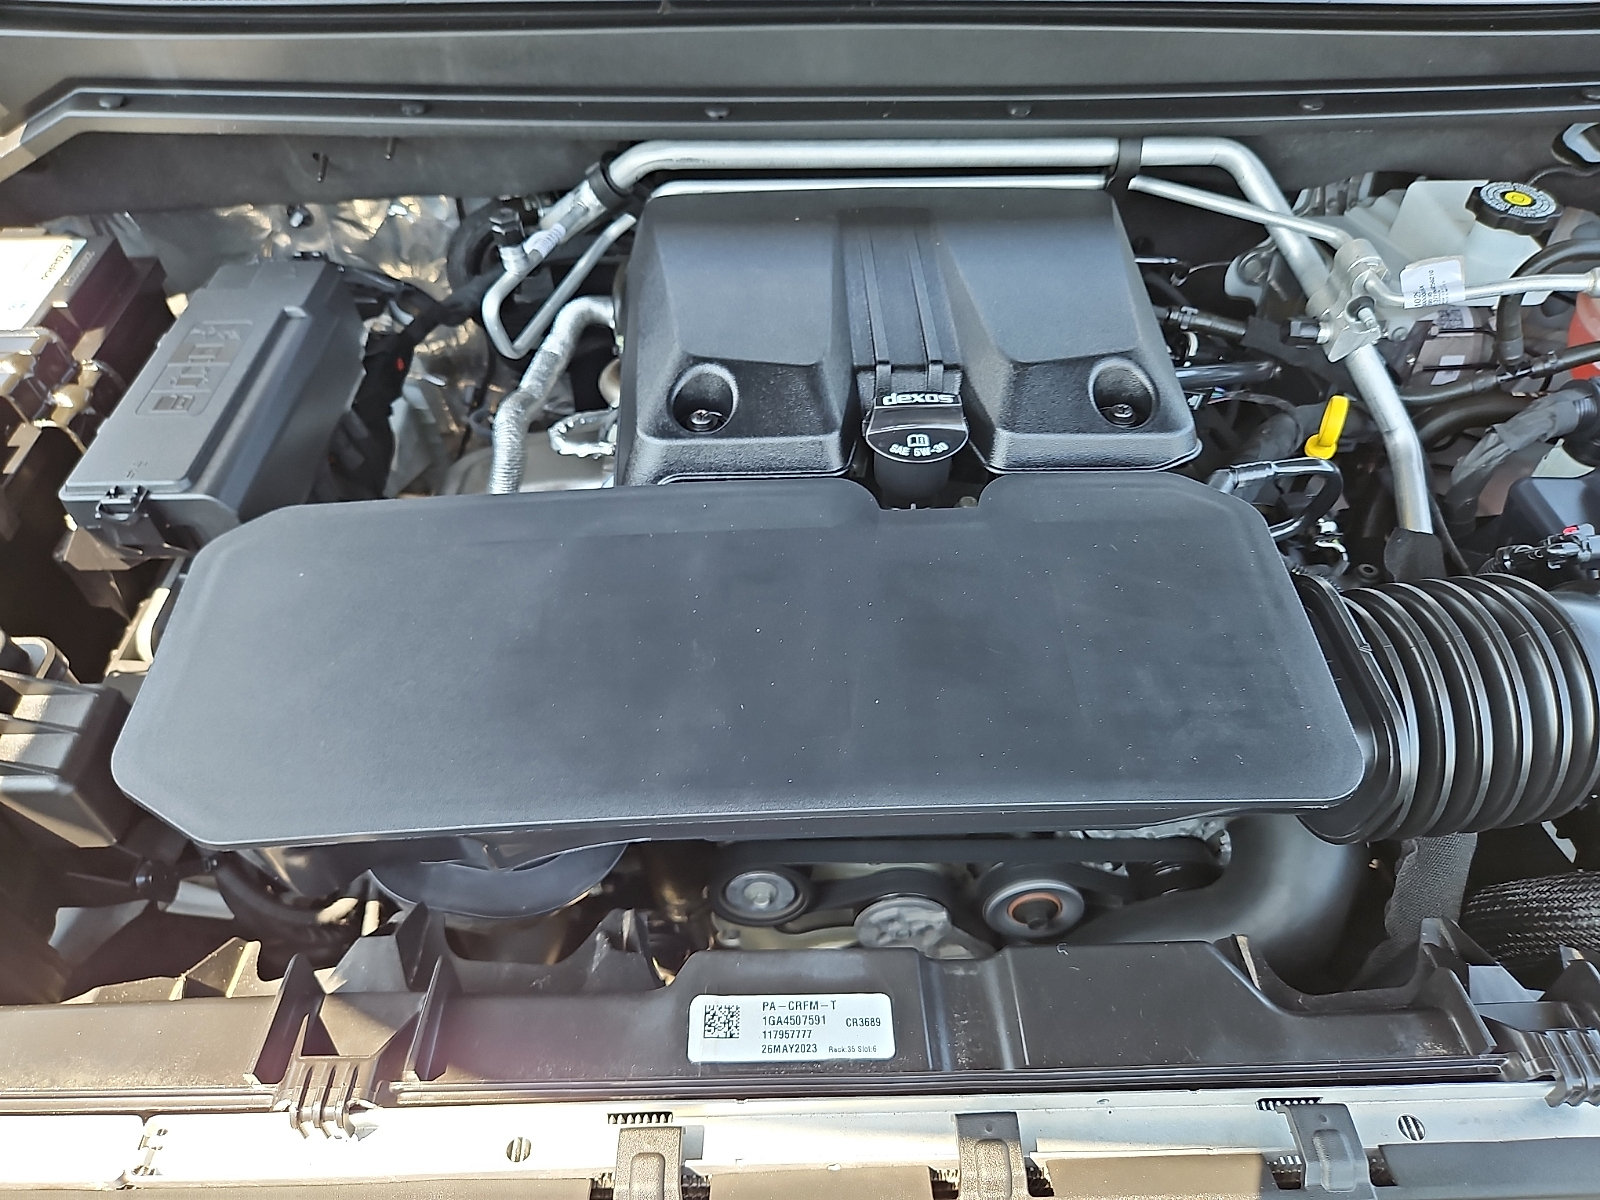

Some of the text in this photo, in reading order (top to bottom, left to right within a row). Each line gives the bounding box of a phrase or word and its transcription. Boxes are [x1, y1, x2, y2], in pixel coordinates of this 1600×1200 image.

[882, 392, 956, 406] dexos
[889, 443, 911, 457] SAE
[762, 1014, 826, 1026] 1GA4507591
[845, 1017, 881, 1028] CR3689
[762, 1029, 812, 1040] 117957777
[761, 1043, 818, 1054] 26MAY2023
